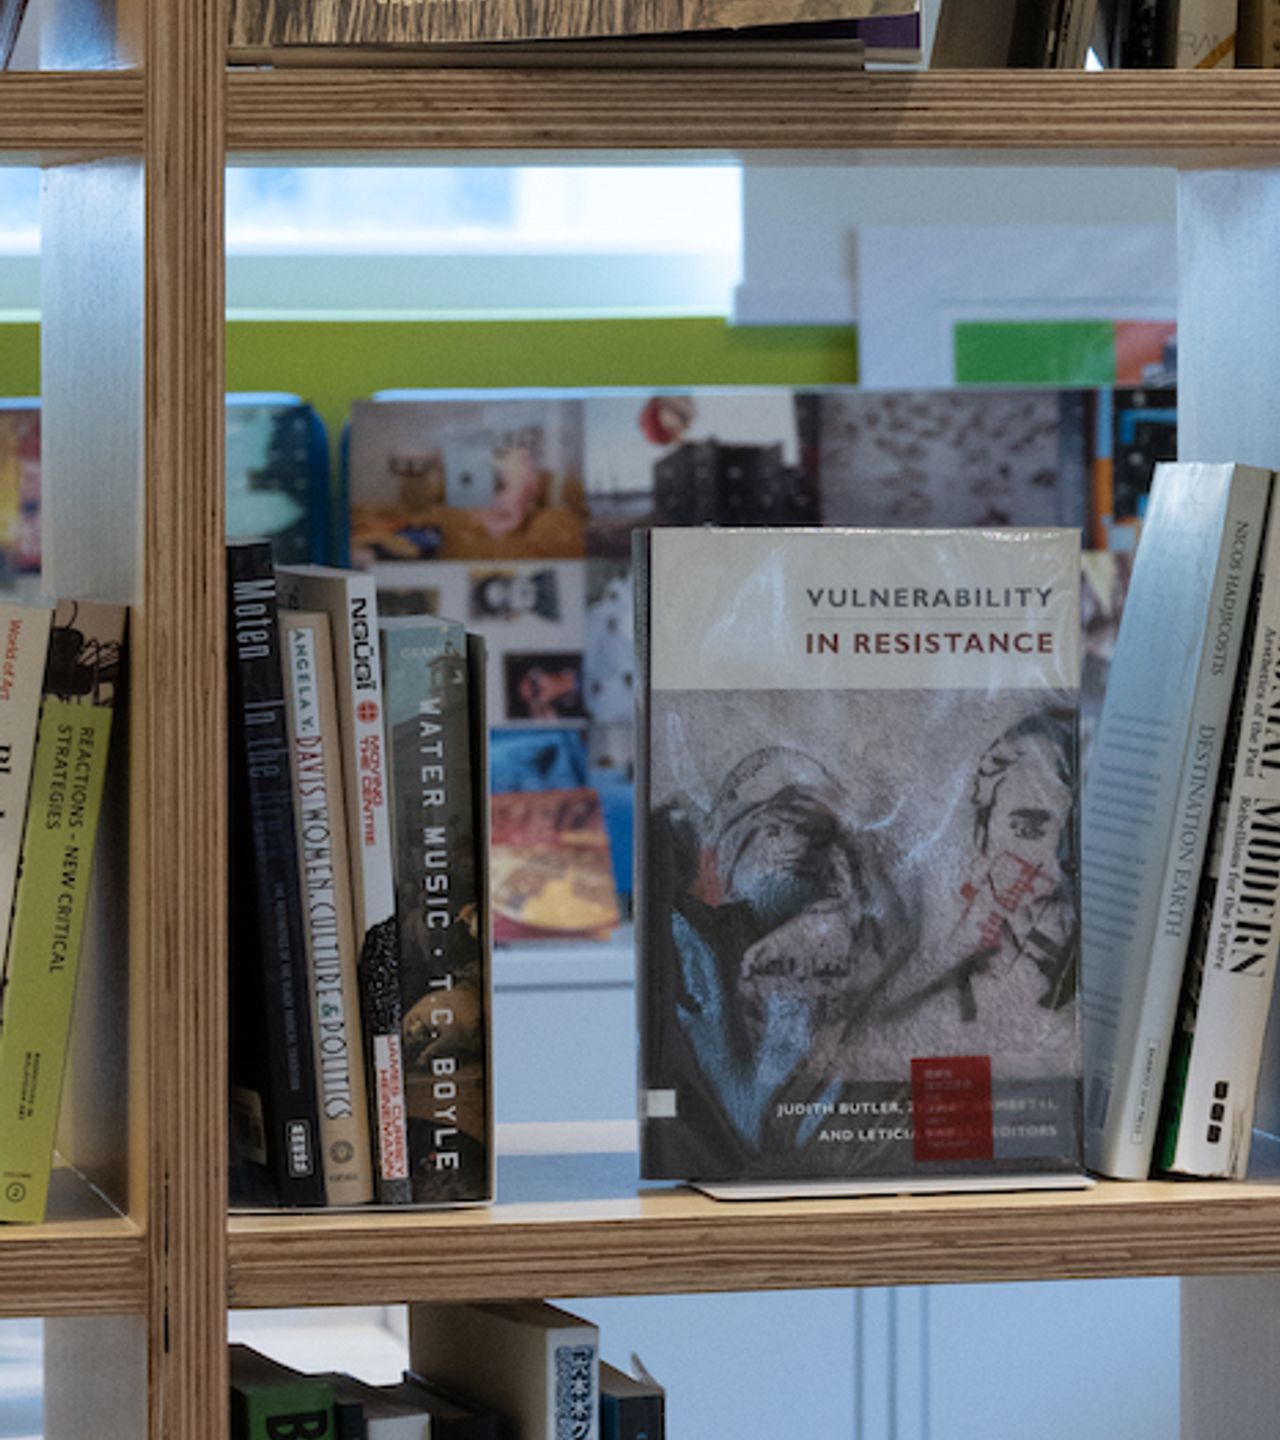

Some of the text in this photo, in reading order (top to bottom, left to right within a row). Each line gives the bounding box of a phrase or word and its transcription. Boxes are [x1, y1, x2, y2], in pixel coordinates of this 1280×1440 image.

[231, 576, 277, 662] Moten
[804, 631, 1055, 656] IN RESISTANCE
[805, 587, 1054, 609] VULNERABILITY
[45, 723, 74, 831] STRATEGIES
[296, 735, 324, 802] DAVIS
[416, 695, 447, 810] WATER
[48, 725, 96, 975] REACTIONS NEW CRITICAL
[421, 827, 459, 932] MUSIC
[1165, 725, 1216, 938] DESTINATION EARTH
[308, 900, 341, 1000] CULTURE
[321, 1020, 353, 1122] POLITICS
[429, 1057, 461, 1174] BOYLE
